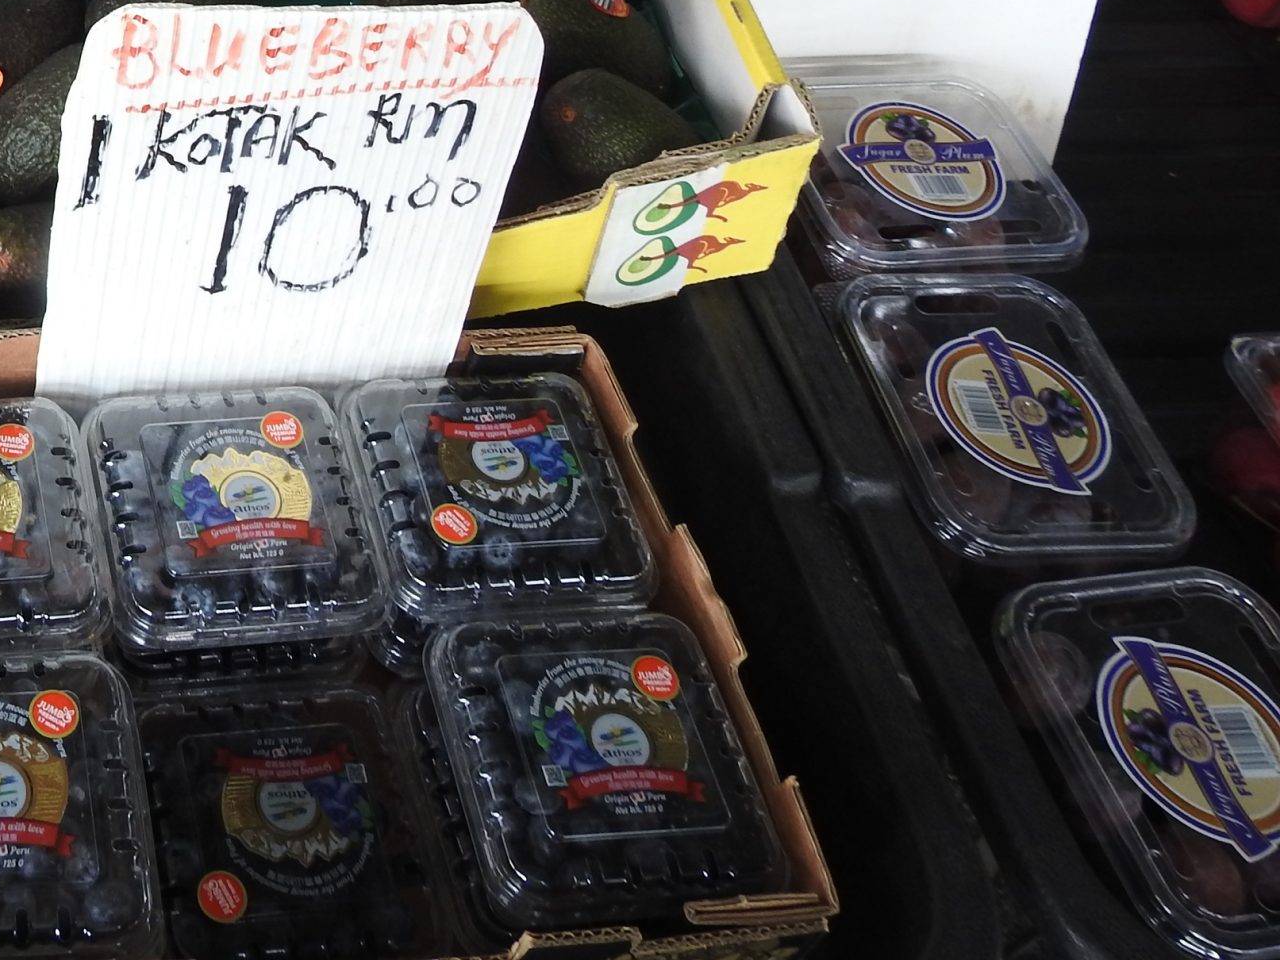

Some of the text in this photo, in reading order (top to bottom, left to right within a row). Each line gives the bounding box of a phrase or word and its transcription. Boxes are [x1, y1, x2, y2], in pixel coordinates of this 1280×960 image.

[112, 13, 521, 99] BLUEBERRY
[72, 114, 112, 212] 1
[890, 164, 970, 175] FRESH FARM
[200, 174, 483, 295] 10.00
[981, 369, 1027, 450] FRESH FARM
[1186, 688, 1254, 797] FRESH FARM
[3, 859, 16, 868] 125
[7, 822, 26, 831] with
[28, 824, 45, 834] love
[10, 846, 30, 855] Peru
